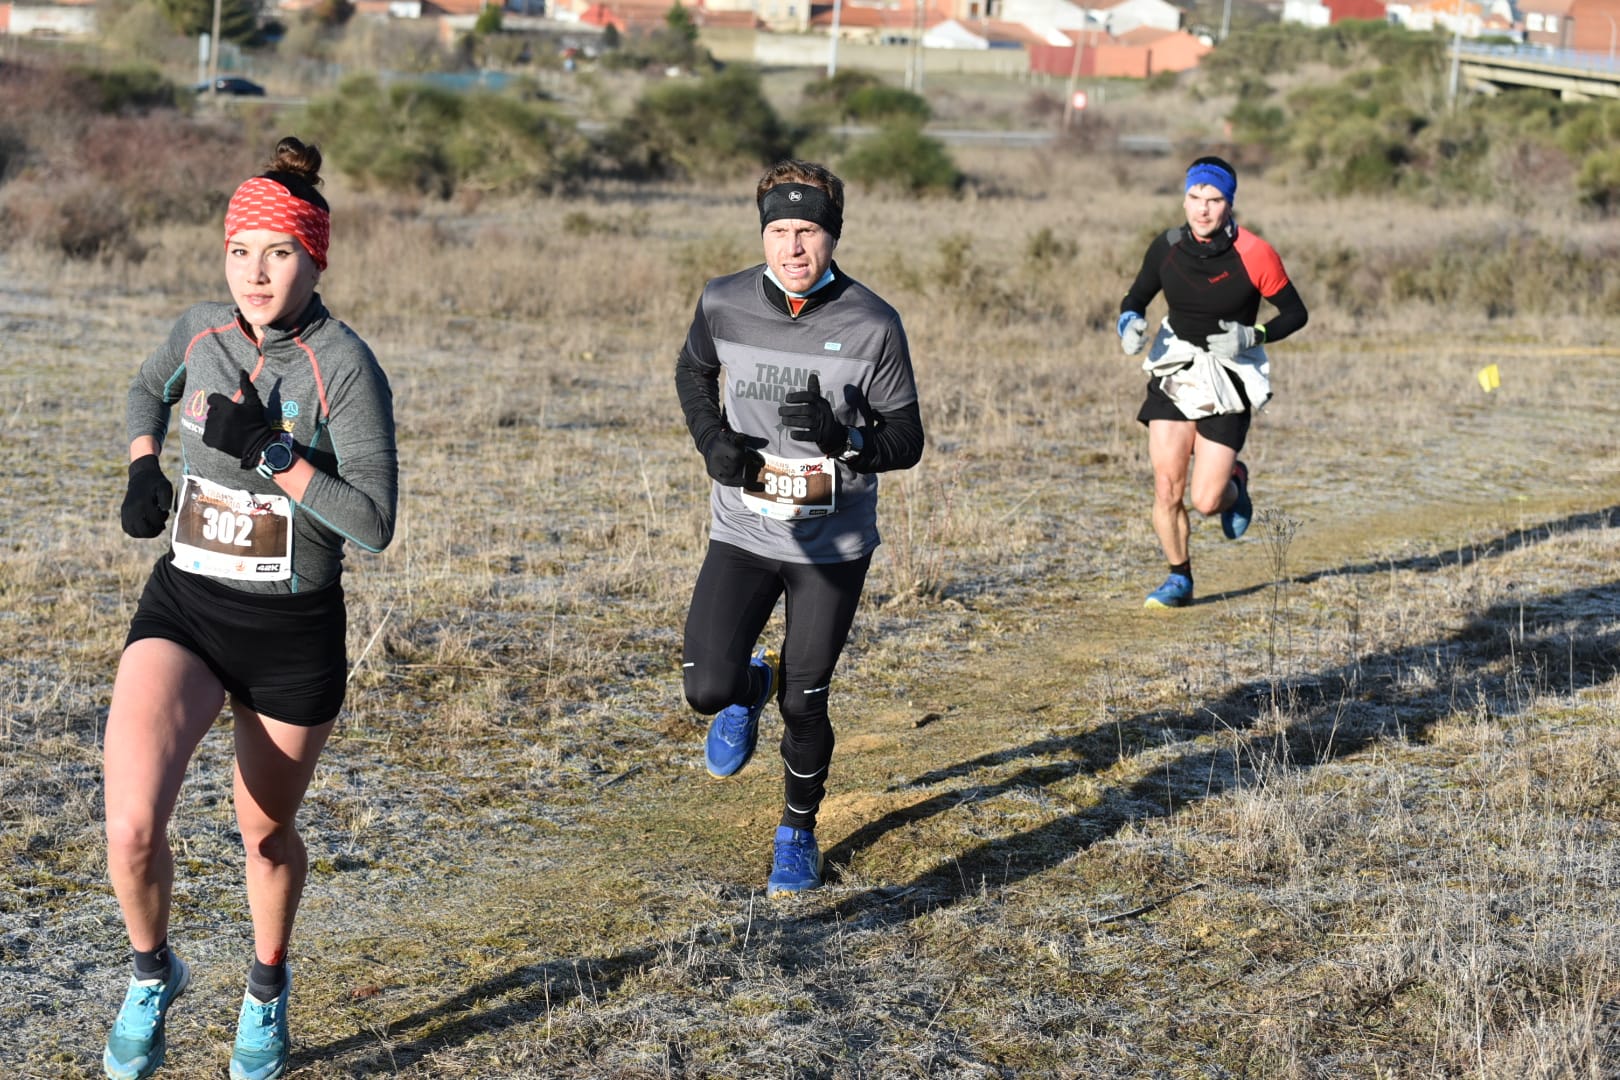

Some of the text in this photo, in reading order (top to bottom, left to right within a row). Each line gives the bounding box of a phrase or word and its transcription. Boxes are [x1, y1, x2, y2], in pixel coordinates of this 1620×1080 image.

[755, 363, 820, 388] TRAN
[736, 380, 837, 408] CANDA
[764, 472, 807, 498] 398
[202, 507, 254, 547] 302
